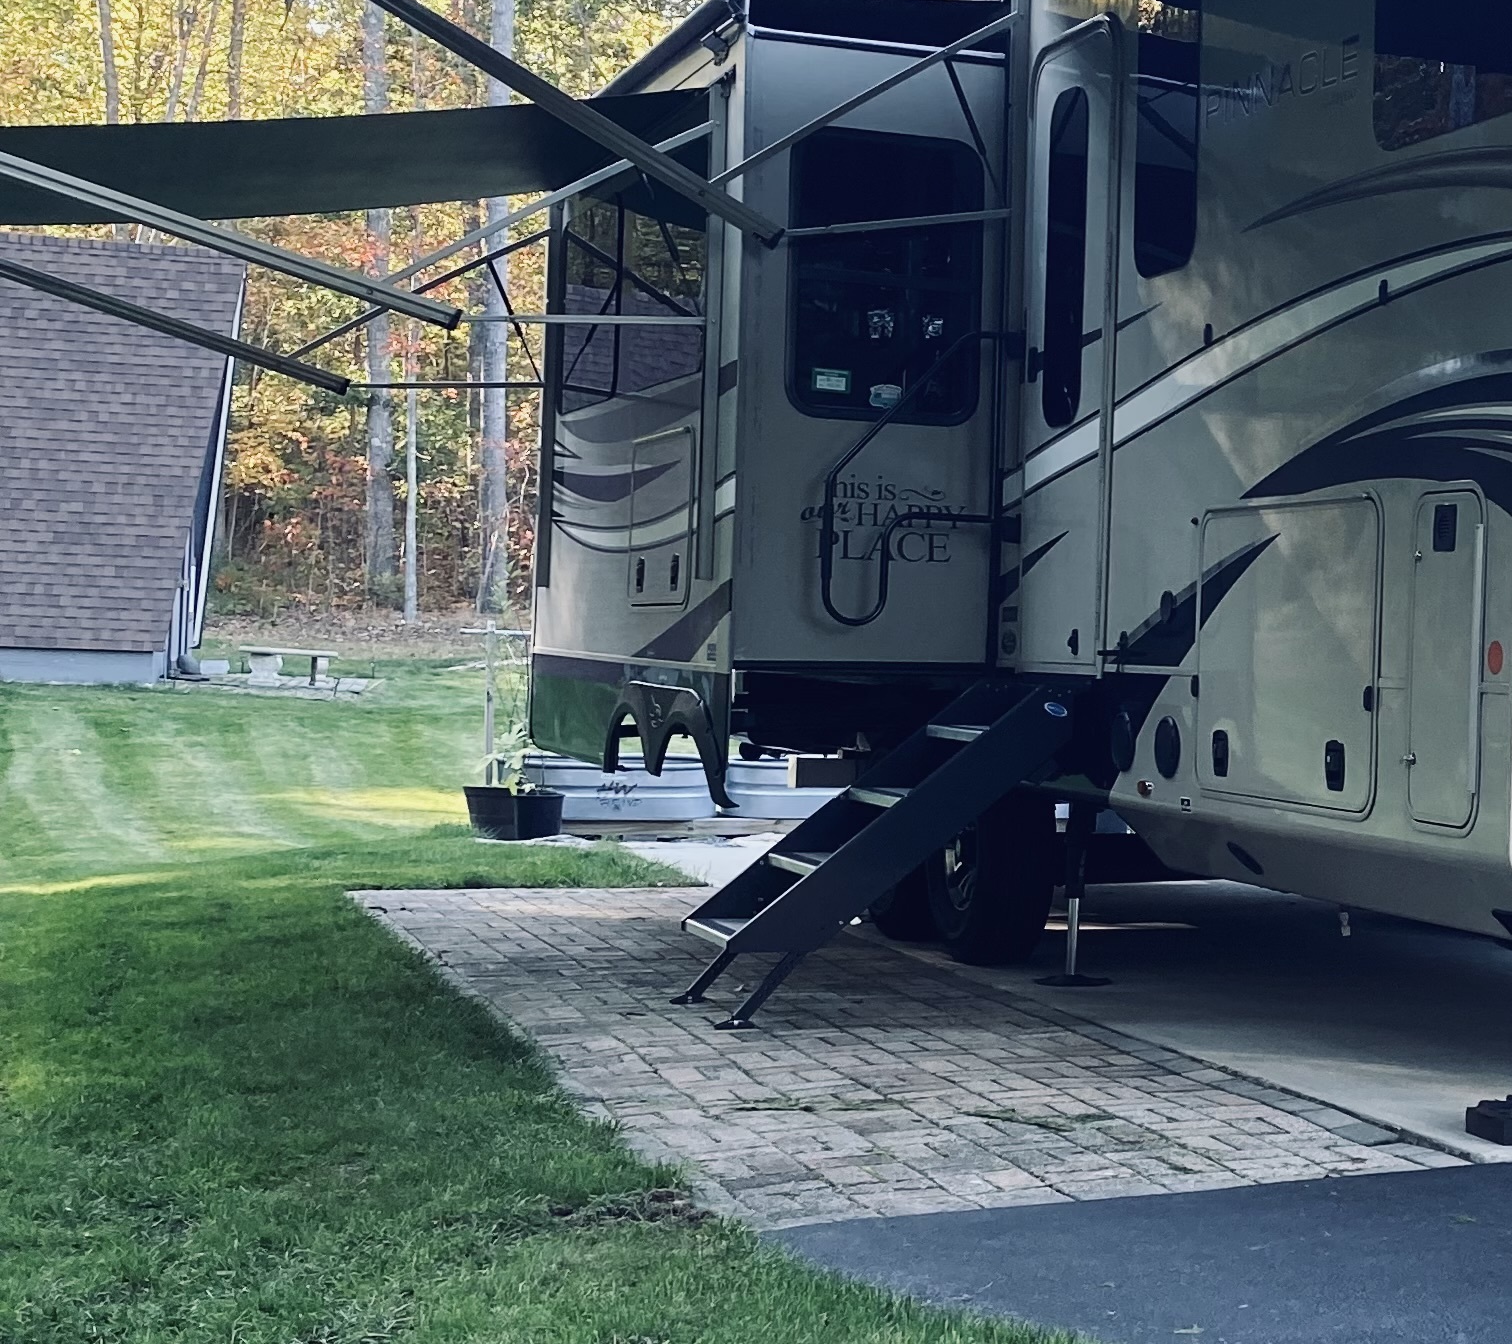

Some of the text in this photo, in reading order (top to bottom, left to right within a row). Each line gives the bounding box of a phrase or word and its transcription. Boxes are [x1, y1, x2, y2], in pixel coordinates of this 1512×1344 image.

[1201, 34, 1360, 128] PINNACLE
[824, 474, 897, 501] his is
[817, 529, 951, 563] PLACE
